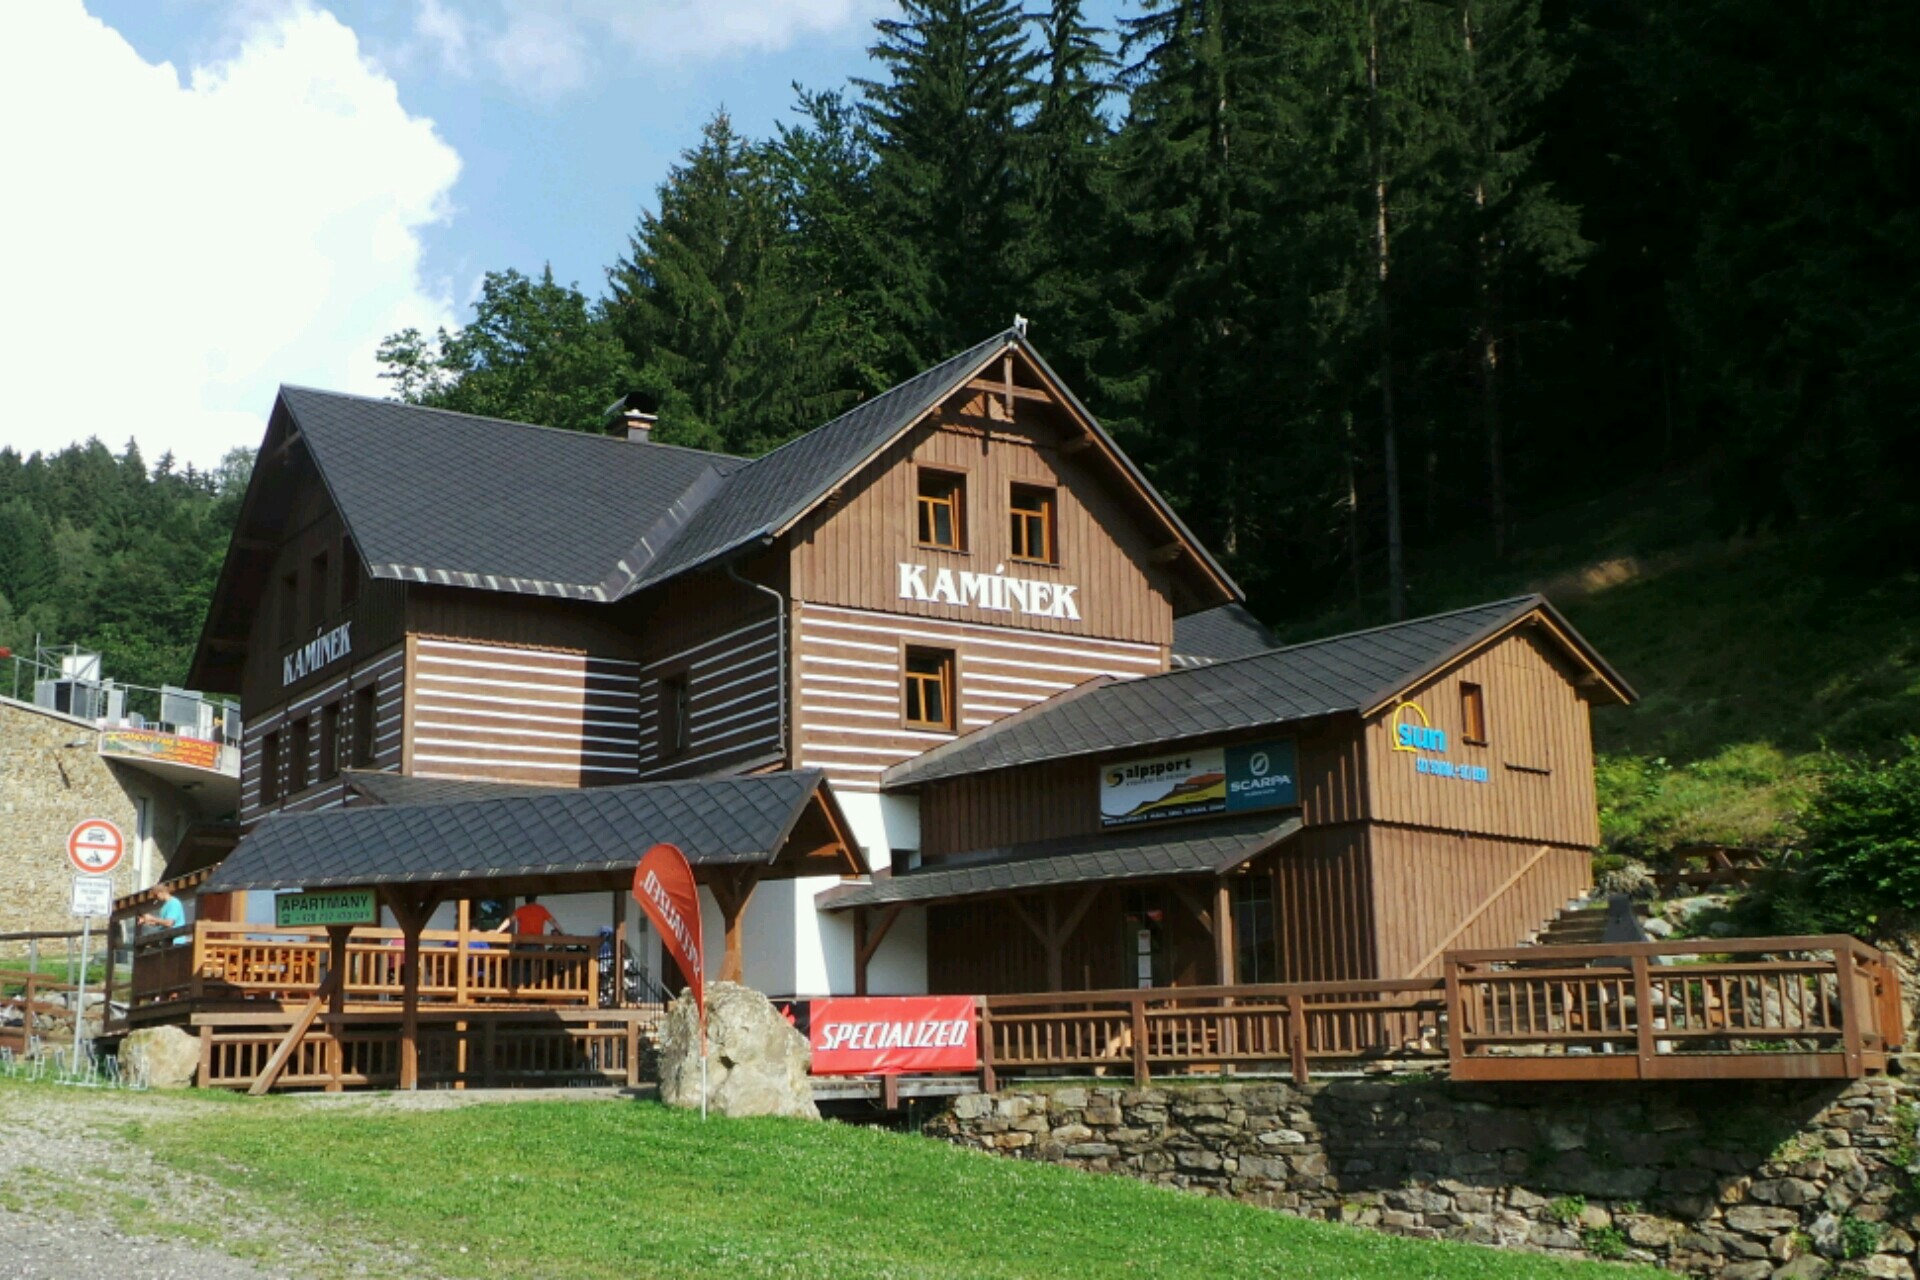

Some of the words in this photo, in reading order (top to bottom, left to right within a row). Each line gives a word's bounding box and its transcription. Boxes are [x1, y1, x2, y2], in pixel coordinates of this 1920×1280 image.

[898, 563, 1082, 621] KAMÍNEK
[282, 621, 352, 687] KAMÍNEK
[1125, 758, 1192, 779] alpsport
[1230, 775, 1291, 792] SCARPA
[281, 895, 368, 911] APARTMANY
[818, 1020, 970, 1050] SPECIALIZED
